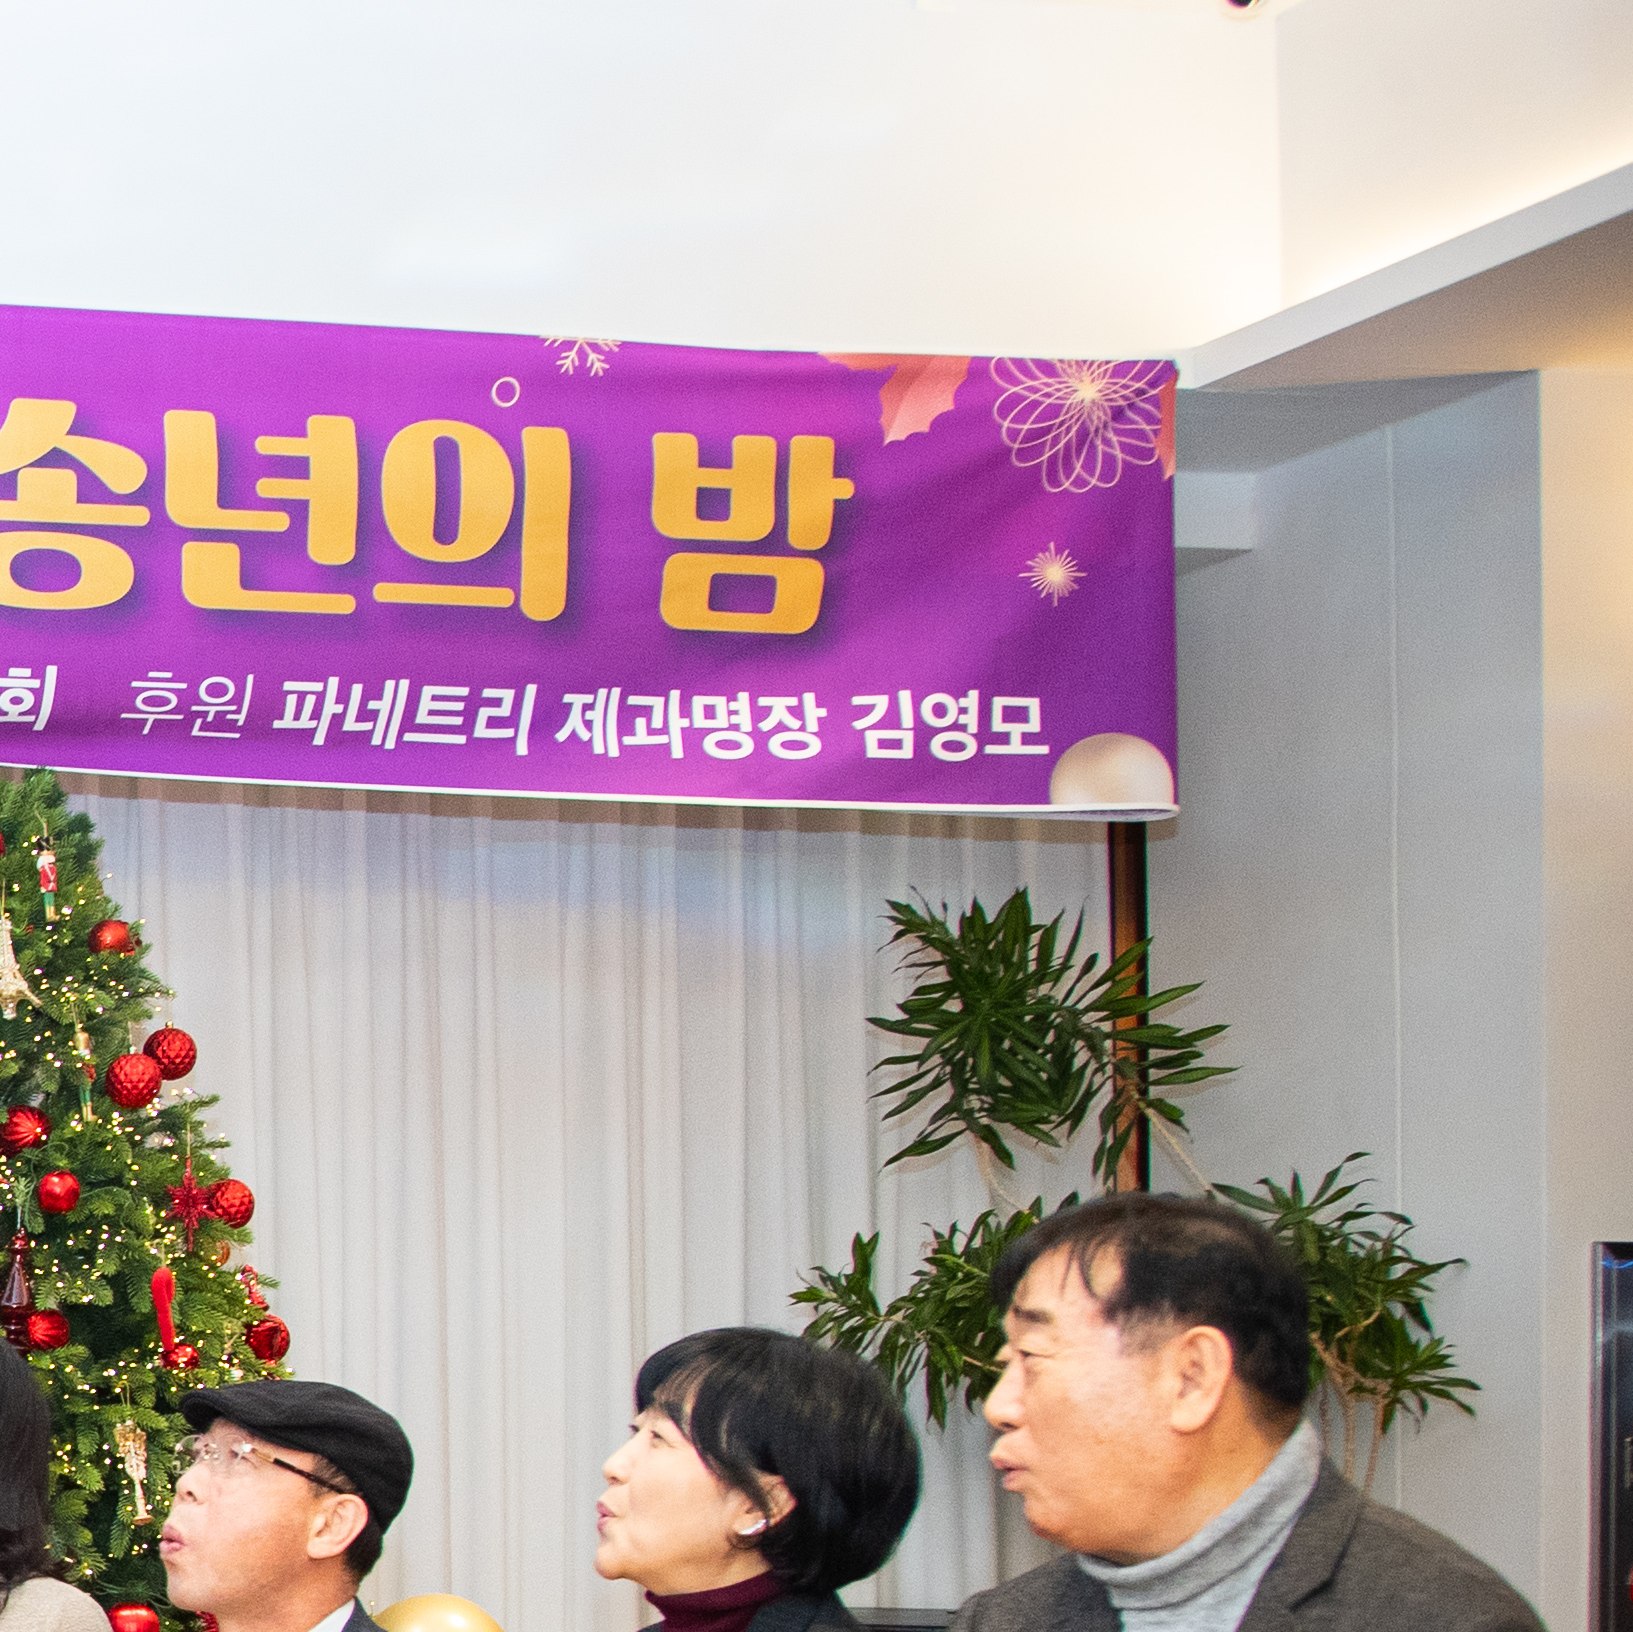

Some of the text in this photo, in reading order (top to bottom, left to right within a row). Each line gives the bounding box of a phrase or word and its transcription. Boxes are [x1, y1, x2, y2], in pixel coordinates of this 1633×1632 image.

[652, 433, 853, 634] 밤
[121, 672, 1049, 761] 후원 파네트리 제과명장 김영모
